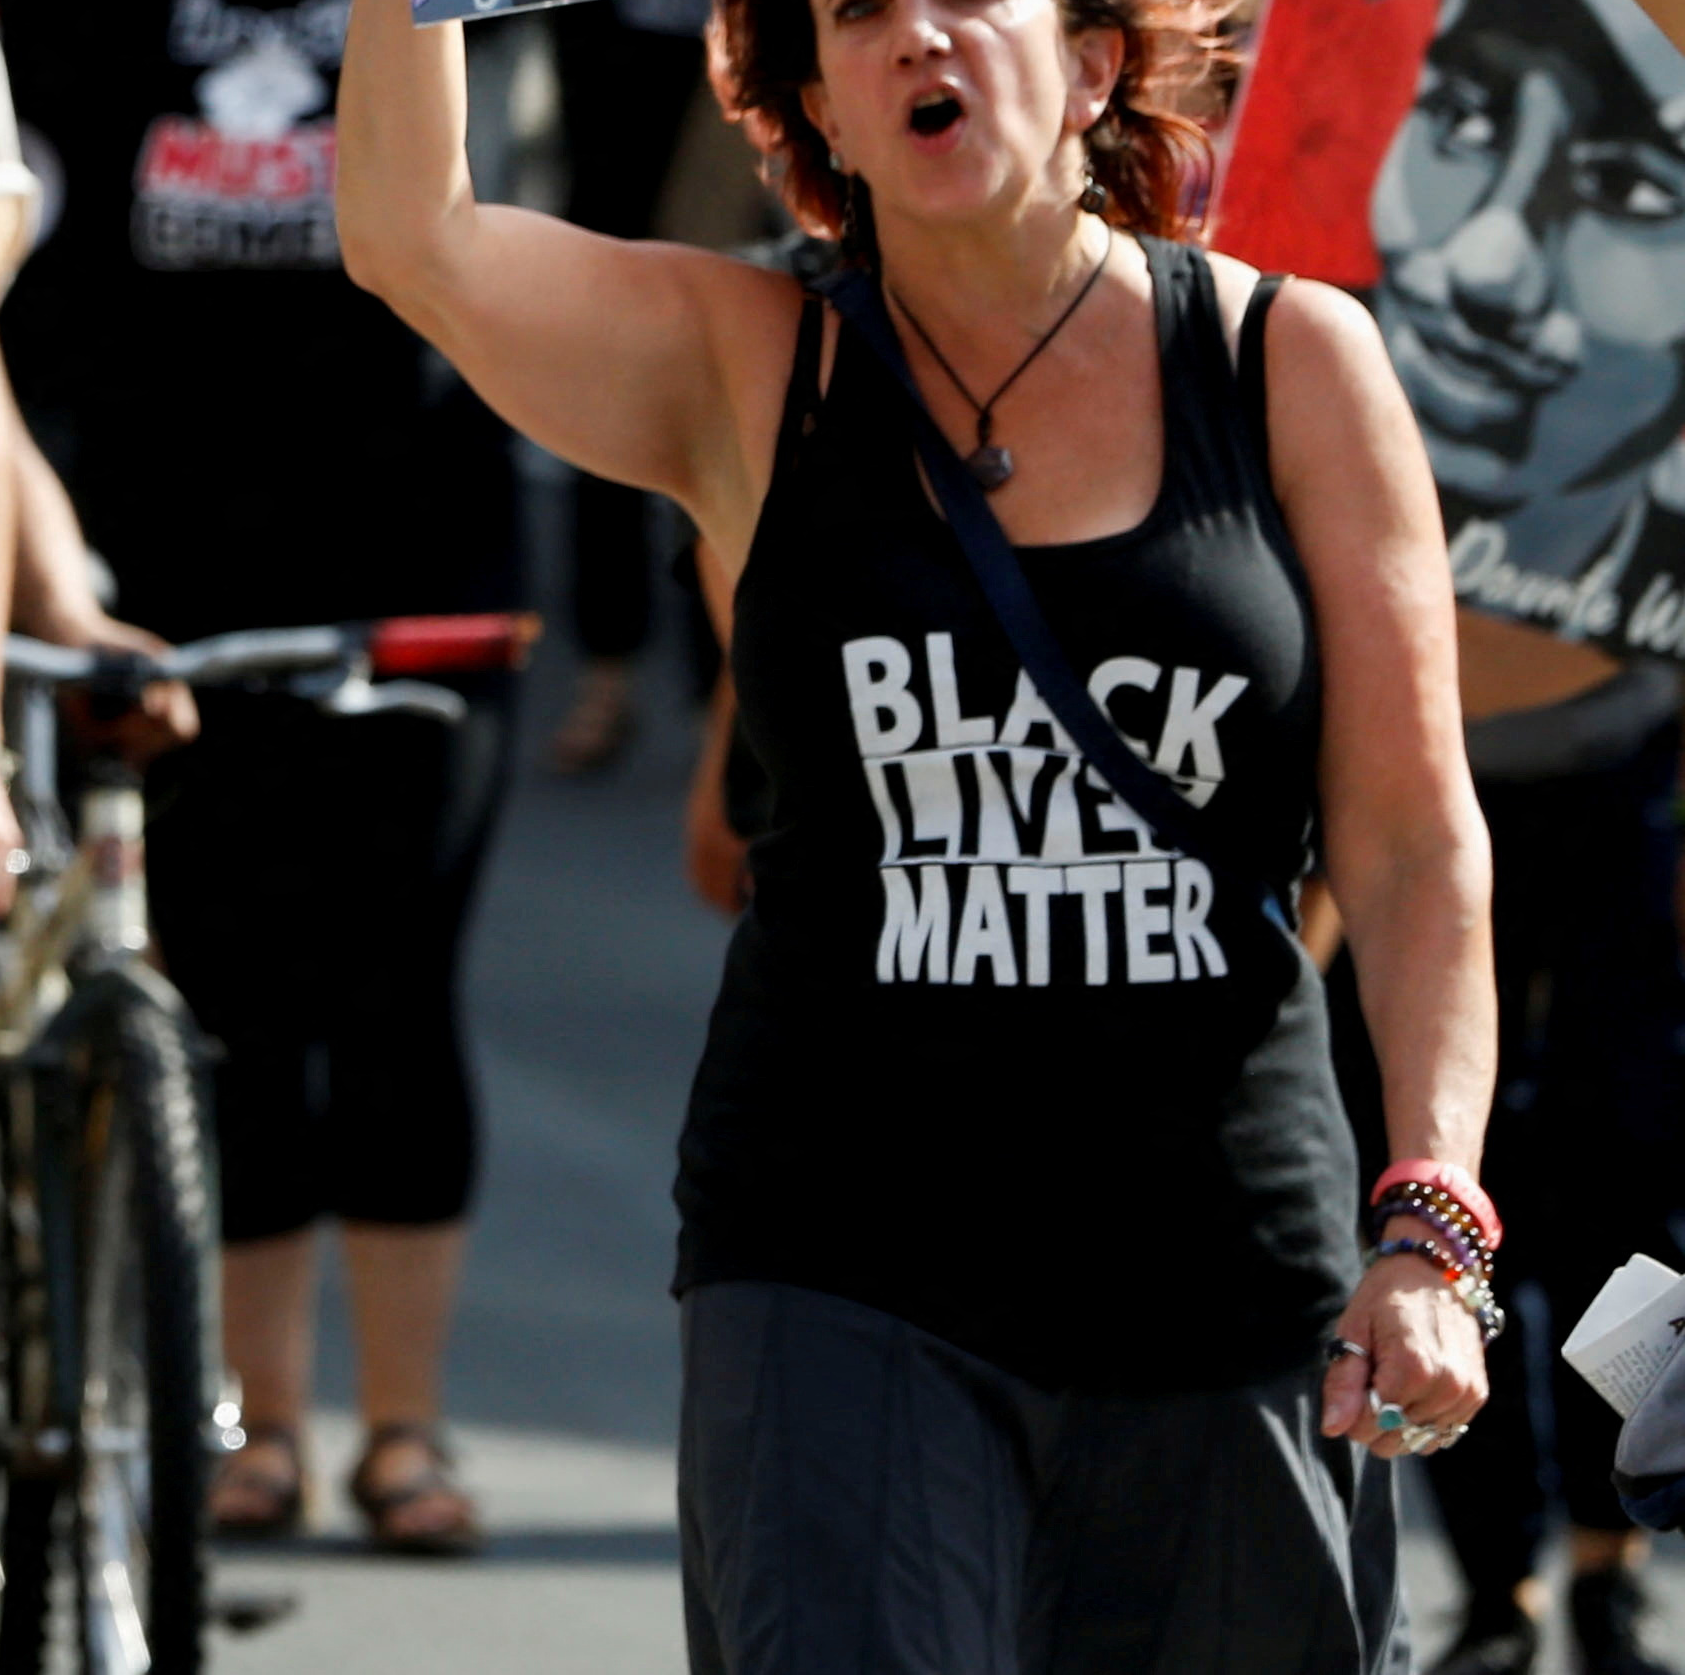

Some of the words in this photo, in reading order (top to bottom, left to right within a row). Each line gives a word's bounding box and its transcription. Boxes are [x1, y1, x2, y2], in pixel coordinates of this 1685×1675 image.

[841, 630, 1251, 783] BLACK
[865, 744, 1222, 866] LIVE
[875, 858, 1230, 987] MATTER
